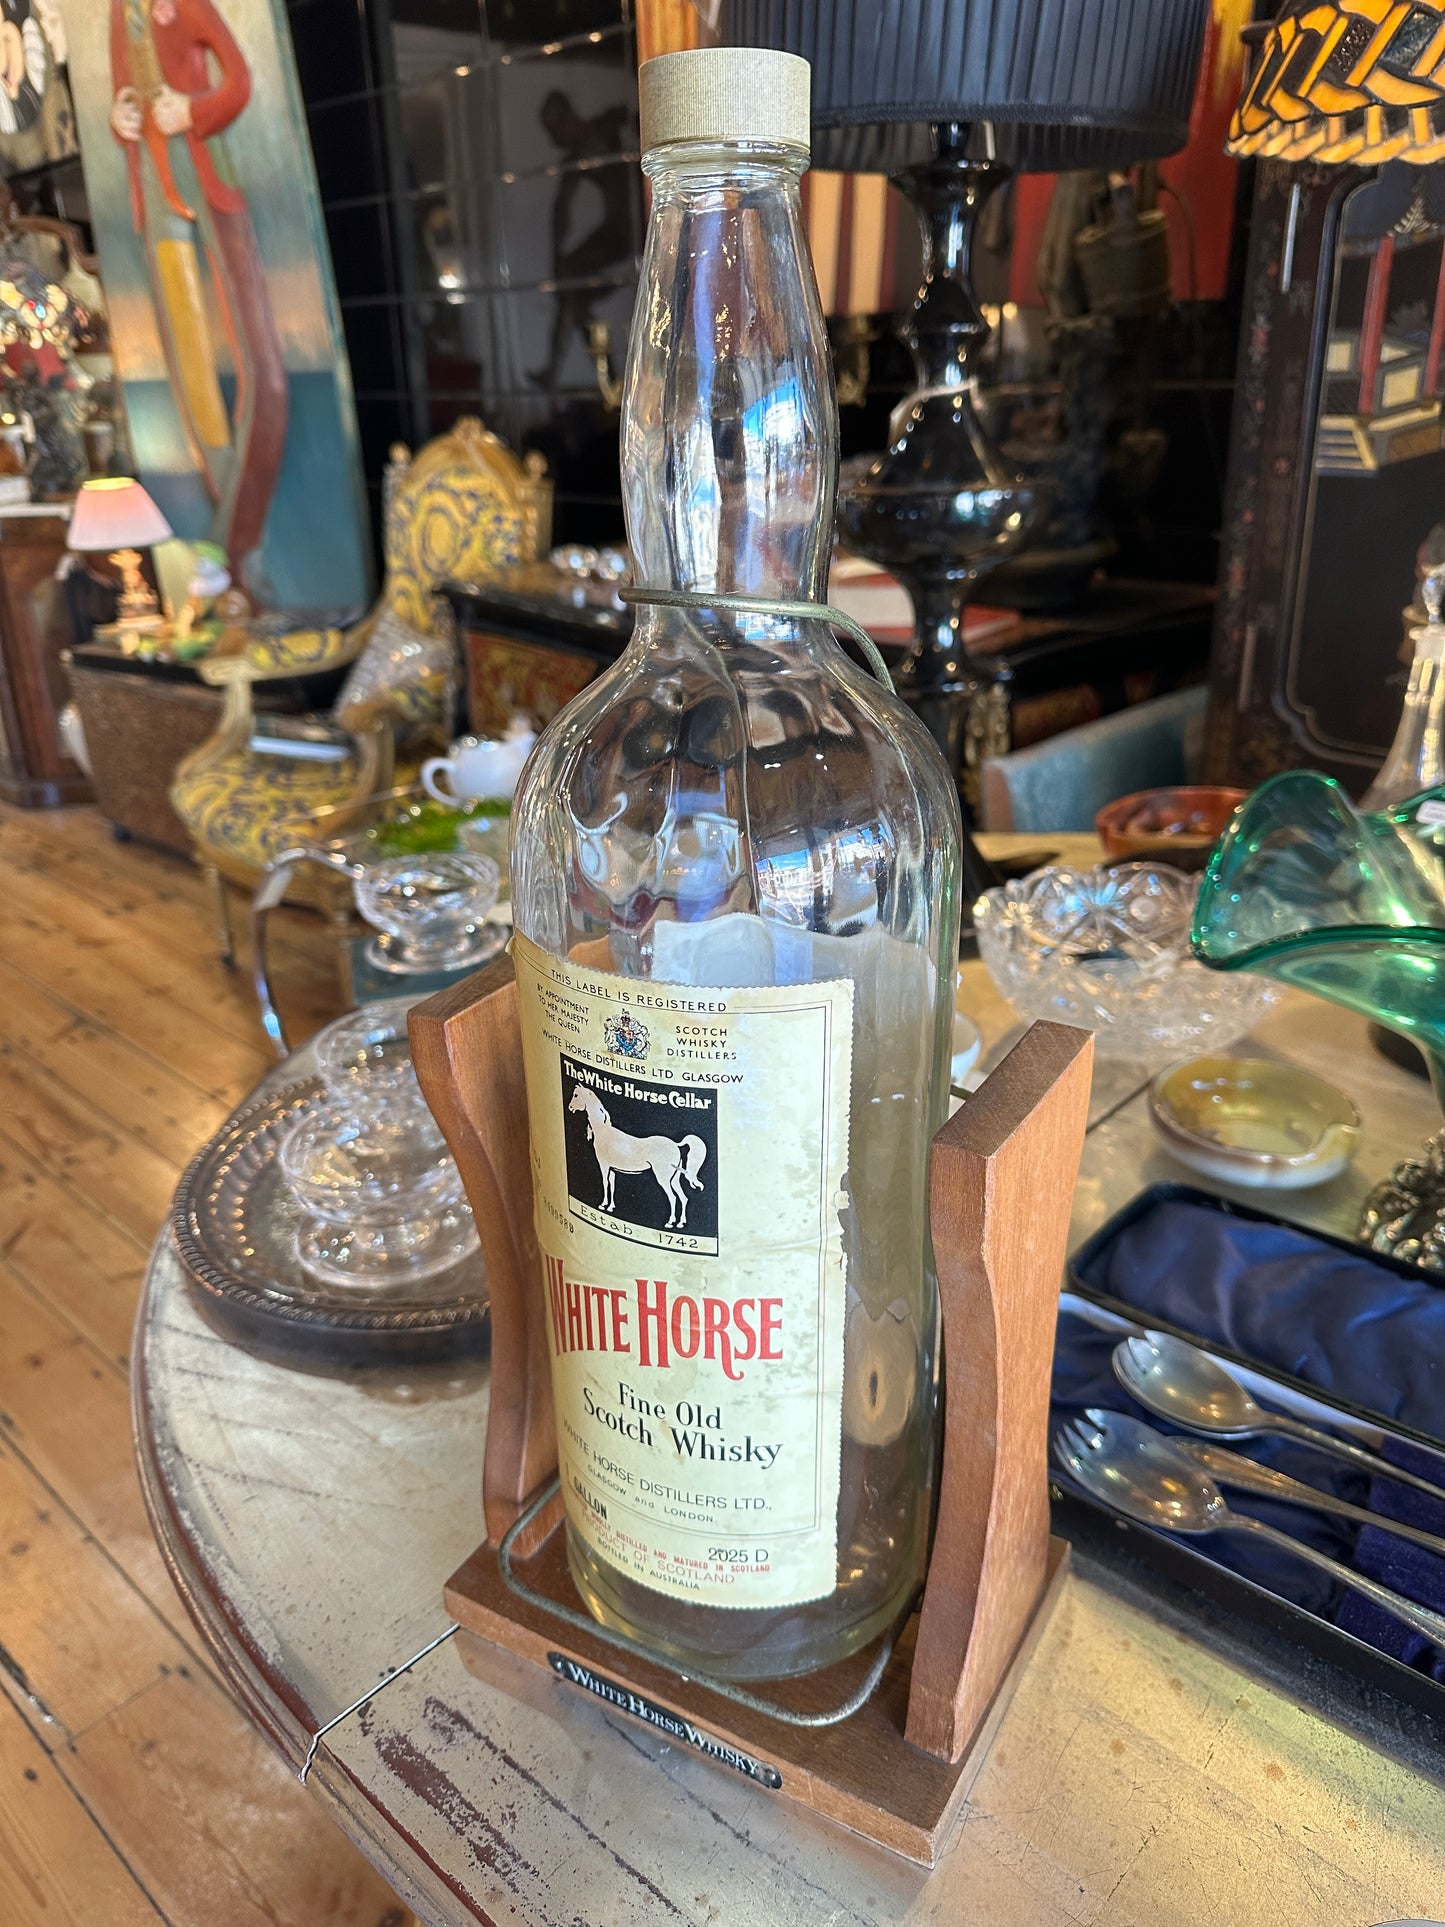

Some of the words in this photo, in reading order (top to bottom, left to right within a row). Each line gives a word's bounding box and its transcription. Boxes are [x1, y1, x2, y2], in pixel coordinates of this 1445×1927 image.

[545, 990, 589, 1015] APPOINTMENT
[551, 969, 571, 985] THIS
[576, 980, 611, 998] LABEL
[618, 991, 630, 1001] IS
[636, 994, 727, 1011] REGISTERED
[538, 994, 546, 1005] TO
[547, 1002, 559, 1013] HER
[561, 1009, 589, 1026] MAJESTY
[545, 1010, 556, 1022] THE
[557, 1017, 580, 1034] QUEEN
[675, 1025, 728, 1036] SCOTCH
[676, 1037, 727, 1048] WHISKY
[542, 1028, 562, 1047] WHITE
[565, 1042, 591, 1060] HORSE
[596, 1054, 646, 1075] DISTILLERS
[681, 1072, 744, 1083] GLASGOW
[667, 1048, 737, 1060] DISTILLERS
[563, 1060, 584, 1080] The
[582, 1068, 623, 1096] White
[624, 1082, 668, 1104] Horse
[668, 1091, 712, 1109] Cellar
[658, 1233, 699, 1249] 1742
[545, 1254, 631, 1357] WHITE
[634, 1278, 784, 1381] HORSE
[617, 1380, 666, 1420] Fine
[675, 1400, 724, 1430] Old
[583, 1386, 654, 1447] Scotch
[669, 1426, 784, 1470] Whisky
[587, 1464, 627, 1495] GLASGOW
[634, 1496, 655, 1509] and
[593, 1450, 635, 1486] HORSE
[640, 1478, 727, 1509] DISTILLERS
[574, 1476, 608, 1520] GALLON
[633, 1550, 649, 1563] OF
[657, 1560, 735, 1584] SCOTLAND
[653, 1549, 667, 1560] AND
[673, 1555, 709, 1570] MATURED
[715, 1564, 724, 1572] IN
[731, 1565, 770, 1573] SCOTLAND
[708, 1547, 748, 1563] 2025
[755, 1549, 769, 1563] D
[633, 1562, 644, 1572] IN
[649, 1570, 700, 1591] AUSTRALIA
